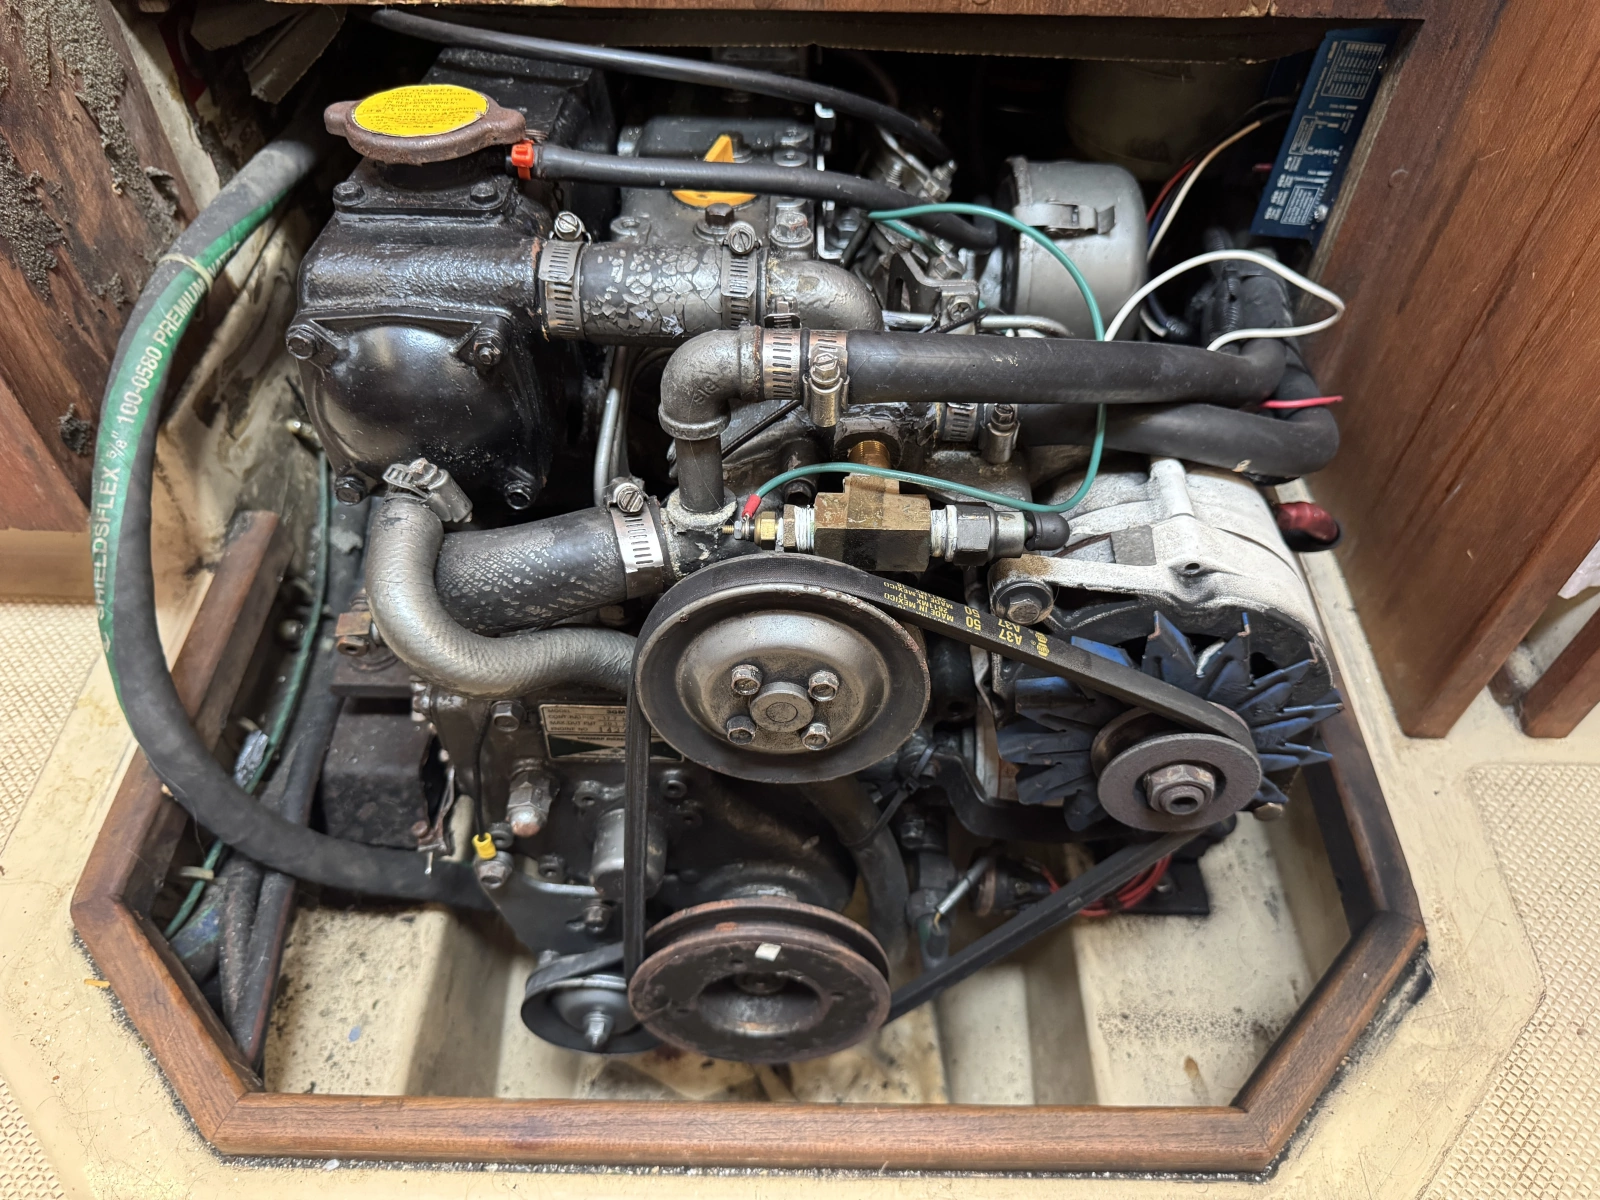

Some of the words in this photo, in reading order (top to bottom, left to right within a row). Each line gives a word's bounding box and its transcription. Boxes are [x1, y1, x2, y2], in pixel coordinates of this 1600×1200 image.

[116, 346, 163, 425] 100-0580
[153, 277, 206, 347] PREMIUM
[883, 592, 916, 609] MEXICO
[919, 604, 928, 613] IN
[930, 608, 954, 622] MADE
[964, 605, 981, 619] 50
[965, 616, 982, 631] 50
[998, 618, 1021, 633] A37
[999, 628, 1023, 646] A37
